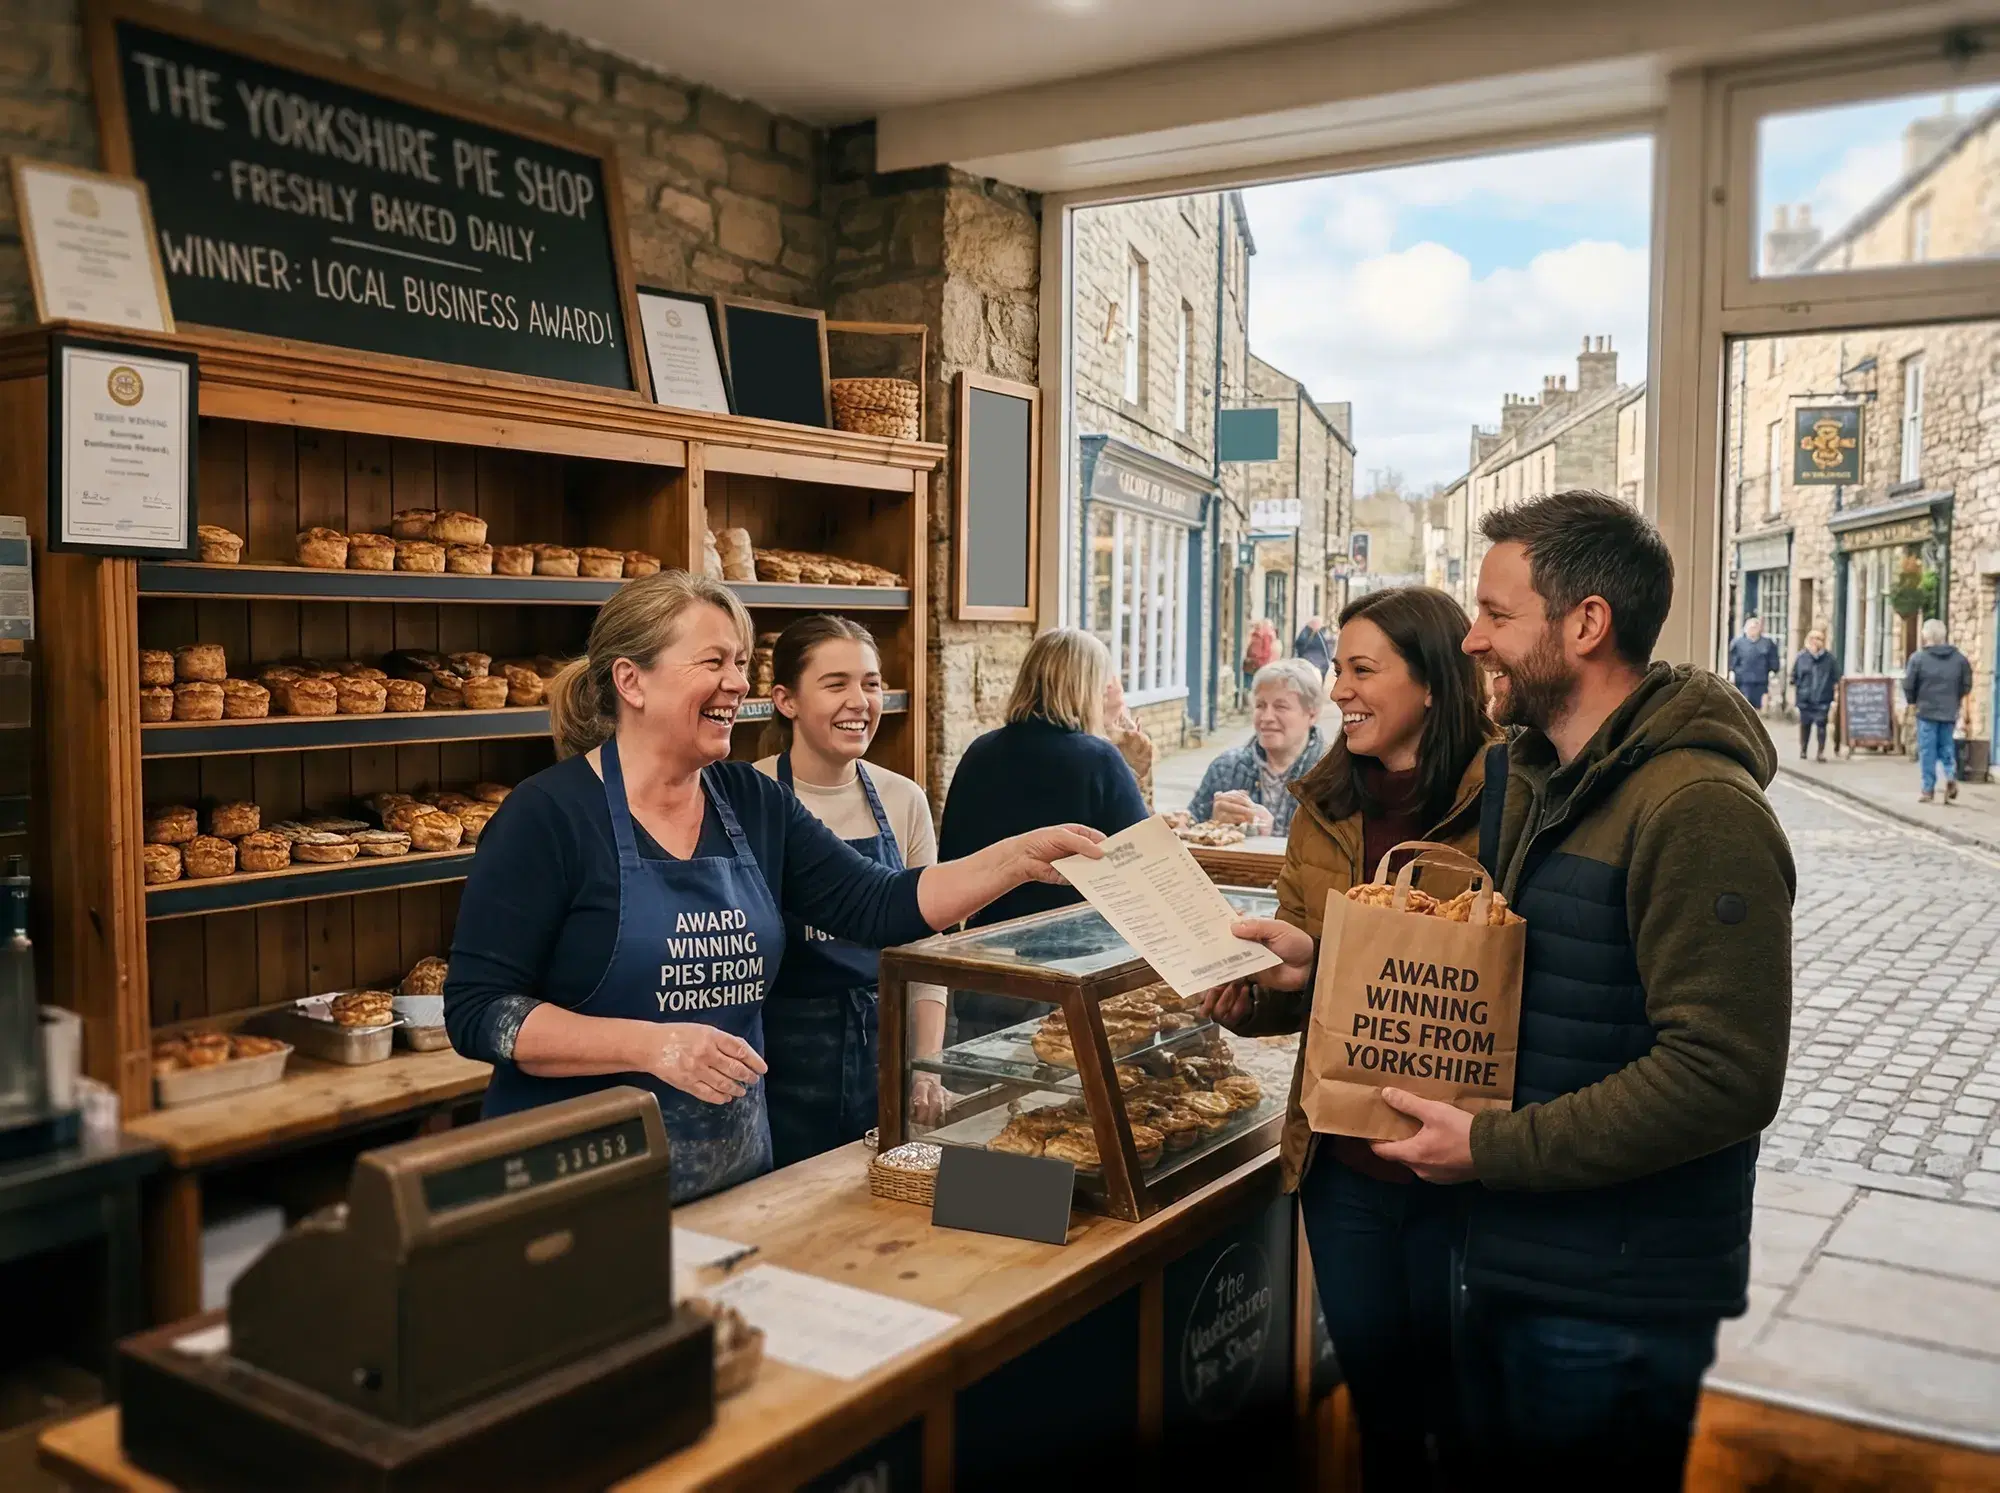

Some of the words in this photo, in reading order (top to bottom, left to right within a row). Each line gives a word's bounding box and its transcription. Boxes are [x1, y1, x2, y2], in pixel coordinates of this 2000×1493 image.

[132, 51, 227, 130] THE
[236, 79, 442, 184] YORKSHIRE
[452, 137, 505, 198] PIE
[514, 156, 595, 220] SHOP
[230, 160, 358, 224] FRESHLY
[370, 192, 457, 245] BAKED
[161, 229, 302, 292] WINNER:
[312, 256, 396, 309] LOCAL
[403, 275, 519, 331] BUSINESS
[529, 300, 615, 348] AWARD!
[675, 908, 747, 933] AWARD
[666, 932, 757, 959] WINNING
[661, 963, 706, 986] PIES
[712, 956, 763, 983] FROM
[1379, 957, 1479, 993] AWARD
[655, 980, 765, 1012] YORKSHIRE
[1366, 984, 1488, 1025] WINNING
[1352, 1013, 1411, 1044] PIES
[1418, 1023, 1495, 1056] FROM
[1344, 1041, 1499, 1087] YORKSHIRE
